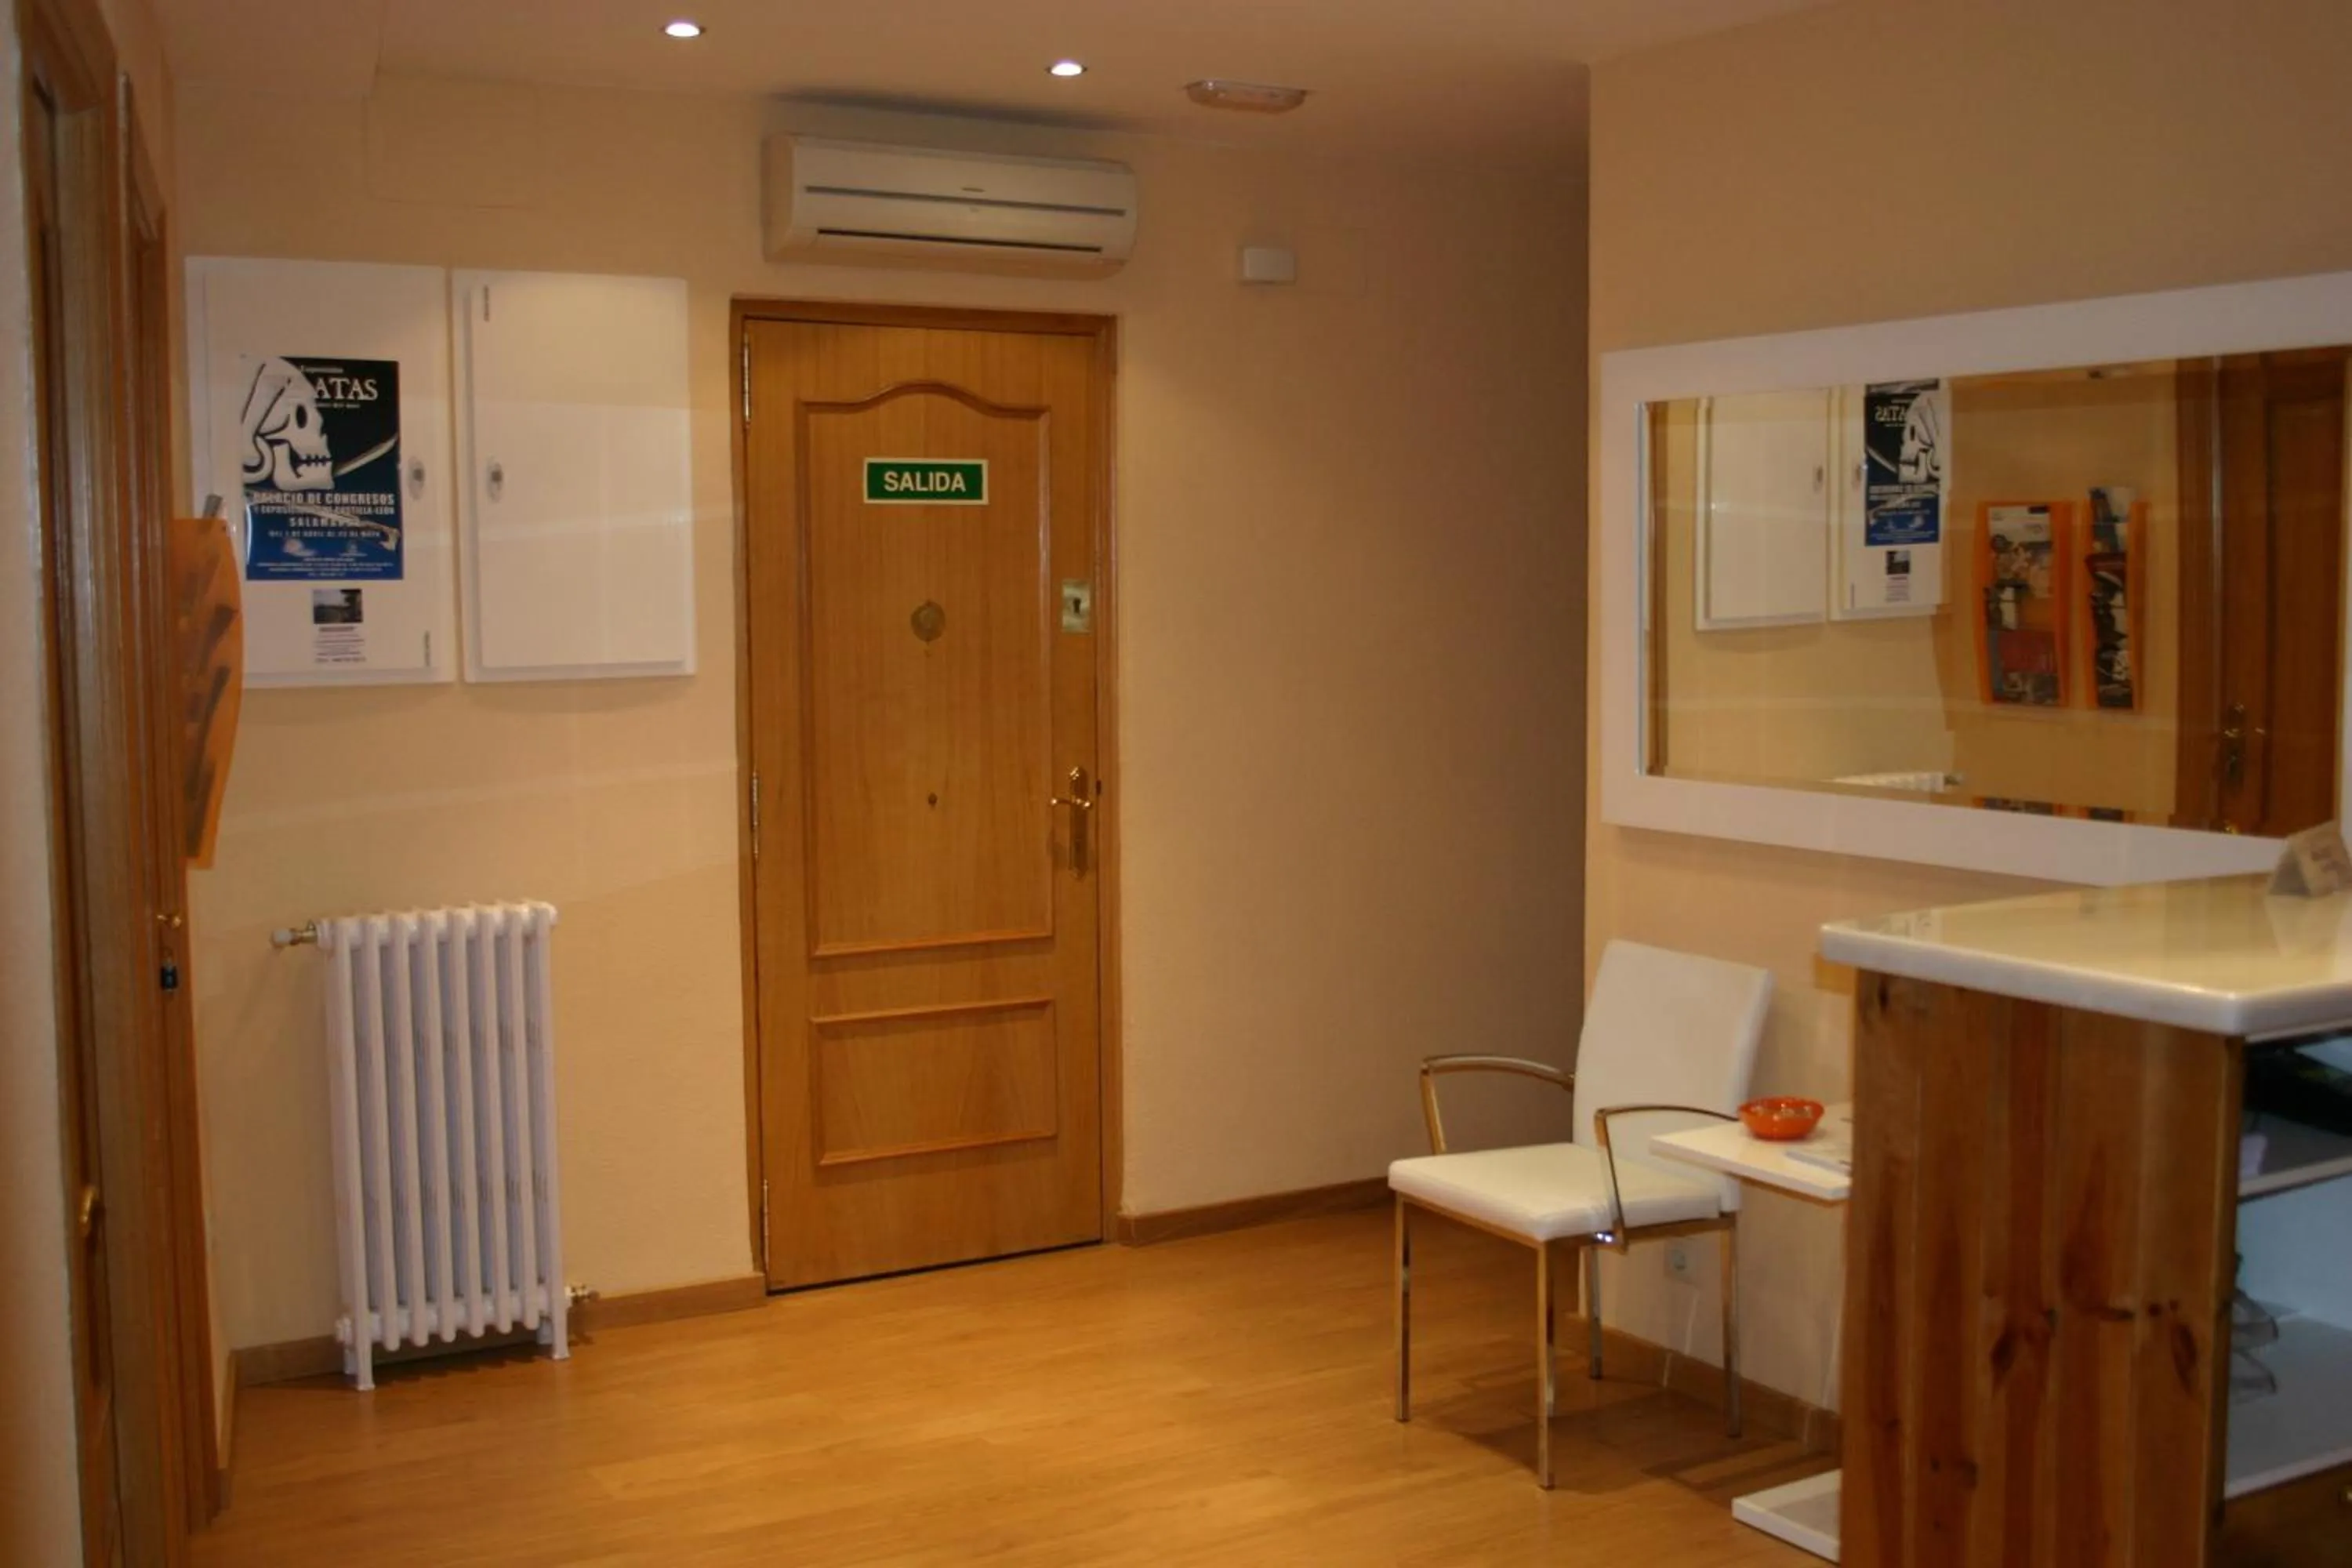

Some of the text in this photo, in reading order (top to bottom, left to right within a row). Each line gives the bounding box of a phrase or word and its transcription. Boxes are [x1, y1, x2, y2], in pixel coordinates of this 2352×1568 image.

[884, 470, 967, 492] SALIDA
[253, 492, 395, 506] ACIO DE CONGRESOS
